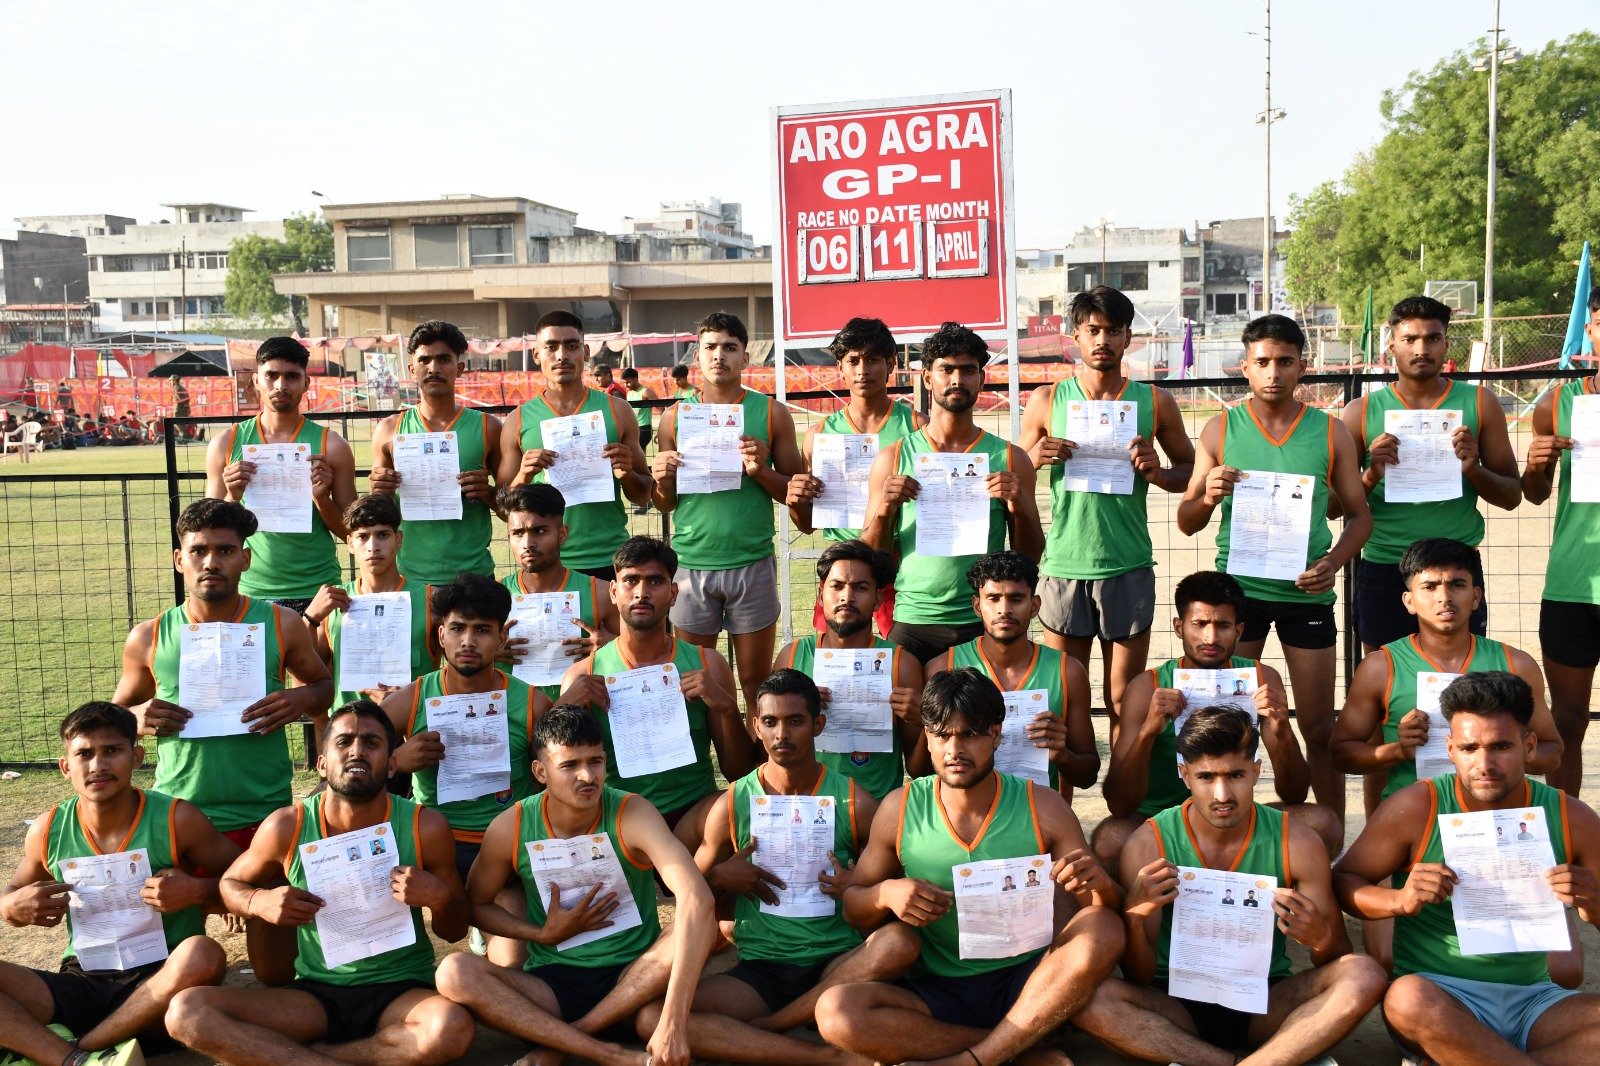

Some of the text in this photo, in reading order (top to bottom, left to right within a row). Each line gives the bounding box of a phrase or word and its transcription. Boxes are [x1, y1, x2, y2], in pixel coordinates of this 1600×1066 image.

[789, 112, 988, 164] ARO AGRA
[822, 159, 961, 200] GP-I
[797, 200, 989, 228] RACE NO DATE MONTH
[809, 228, 977, 272] 06 11 APRIL
[1033, 325, 1057, 333] TITAN
[101, 378, 111, 389] 2
[103, 408, 115, 417] 10
